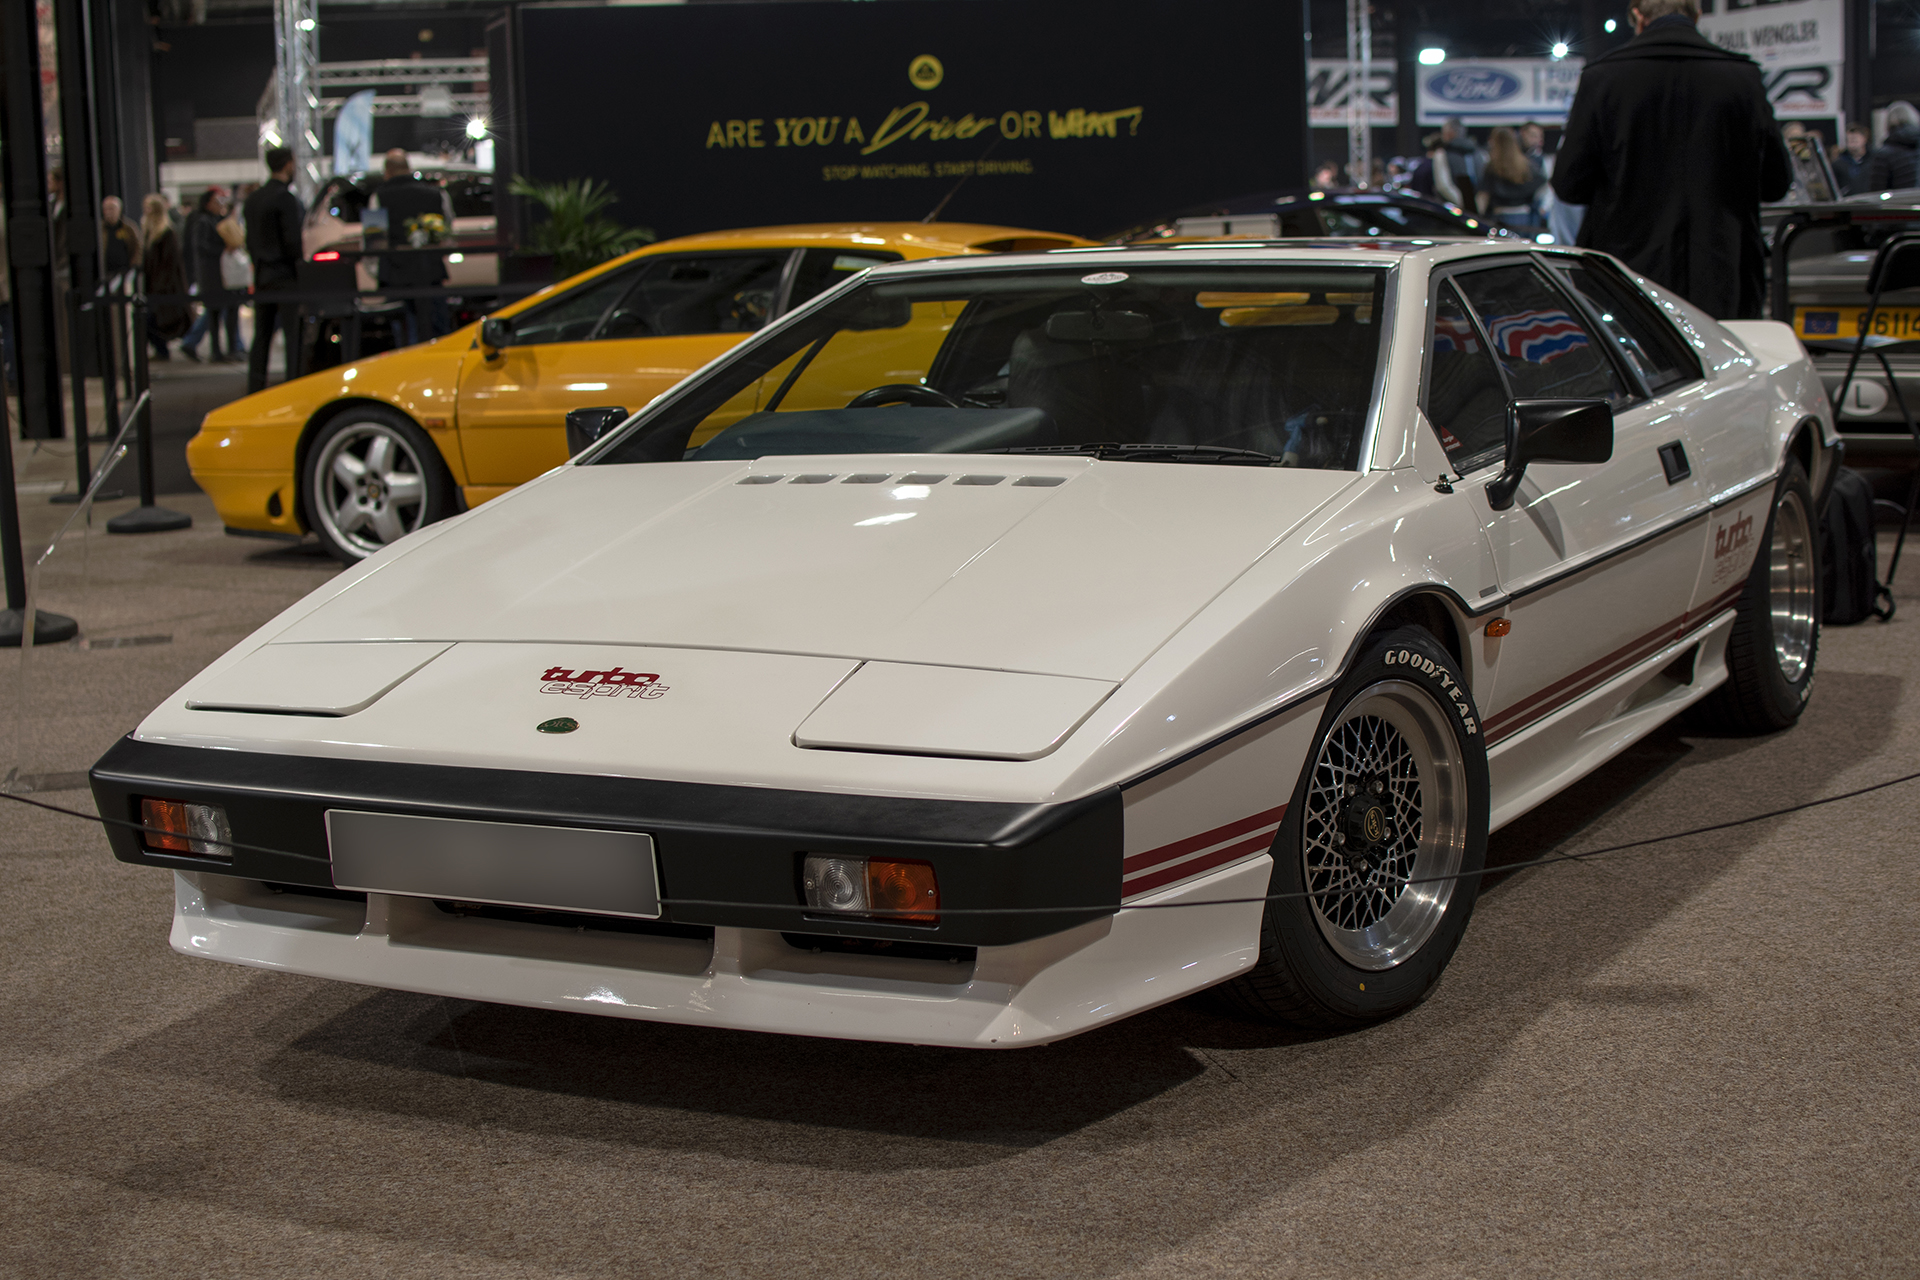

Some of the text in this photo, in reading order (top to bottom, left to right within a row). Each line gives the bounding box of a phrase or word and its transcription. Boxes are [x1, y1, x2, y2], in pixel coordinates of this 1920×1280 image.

[1442, 70, 1505, 99] Ford
[706, 119, 766, 149] ARE
[774, 116, 841, 147] YOU
[843, 117, 865, 145] A
[860, 100, 996, 156] Driver
[1000, 110, 1042, 140] OR
[1856, 384, 1870, 409] L
[540, 666, 661, 686] turbo
[539, 680, 671, 700] esprit
[1384, 650, 1477, 736] GOODYEAR
